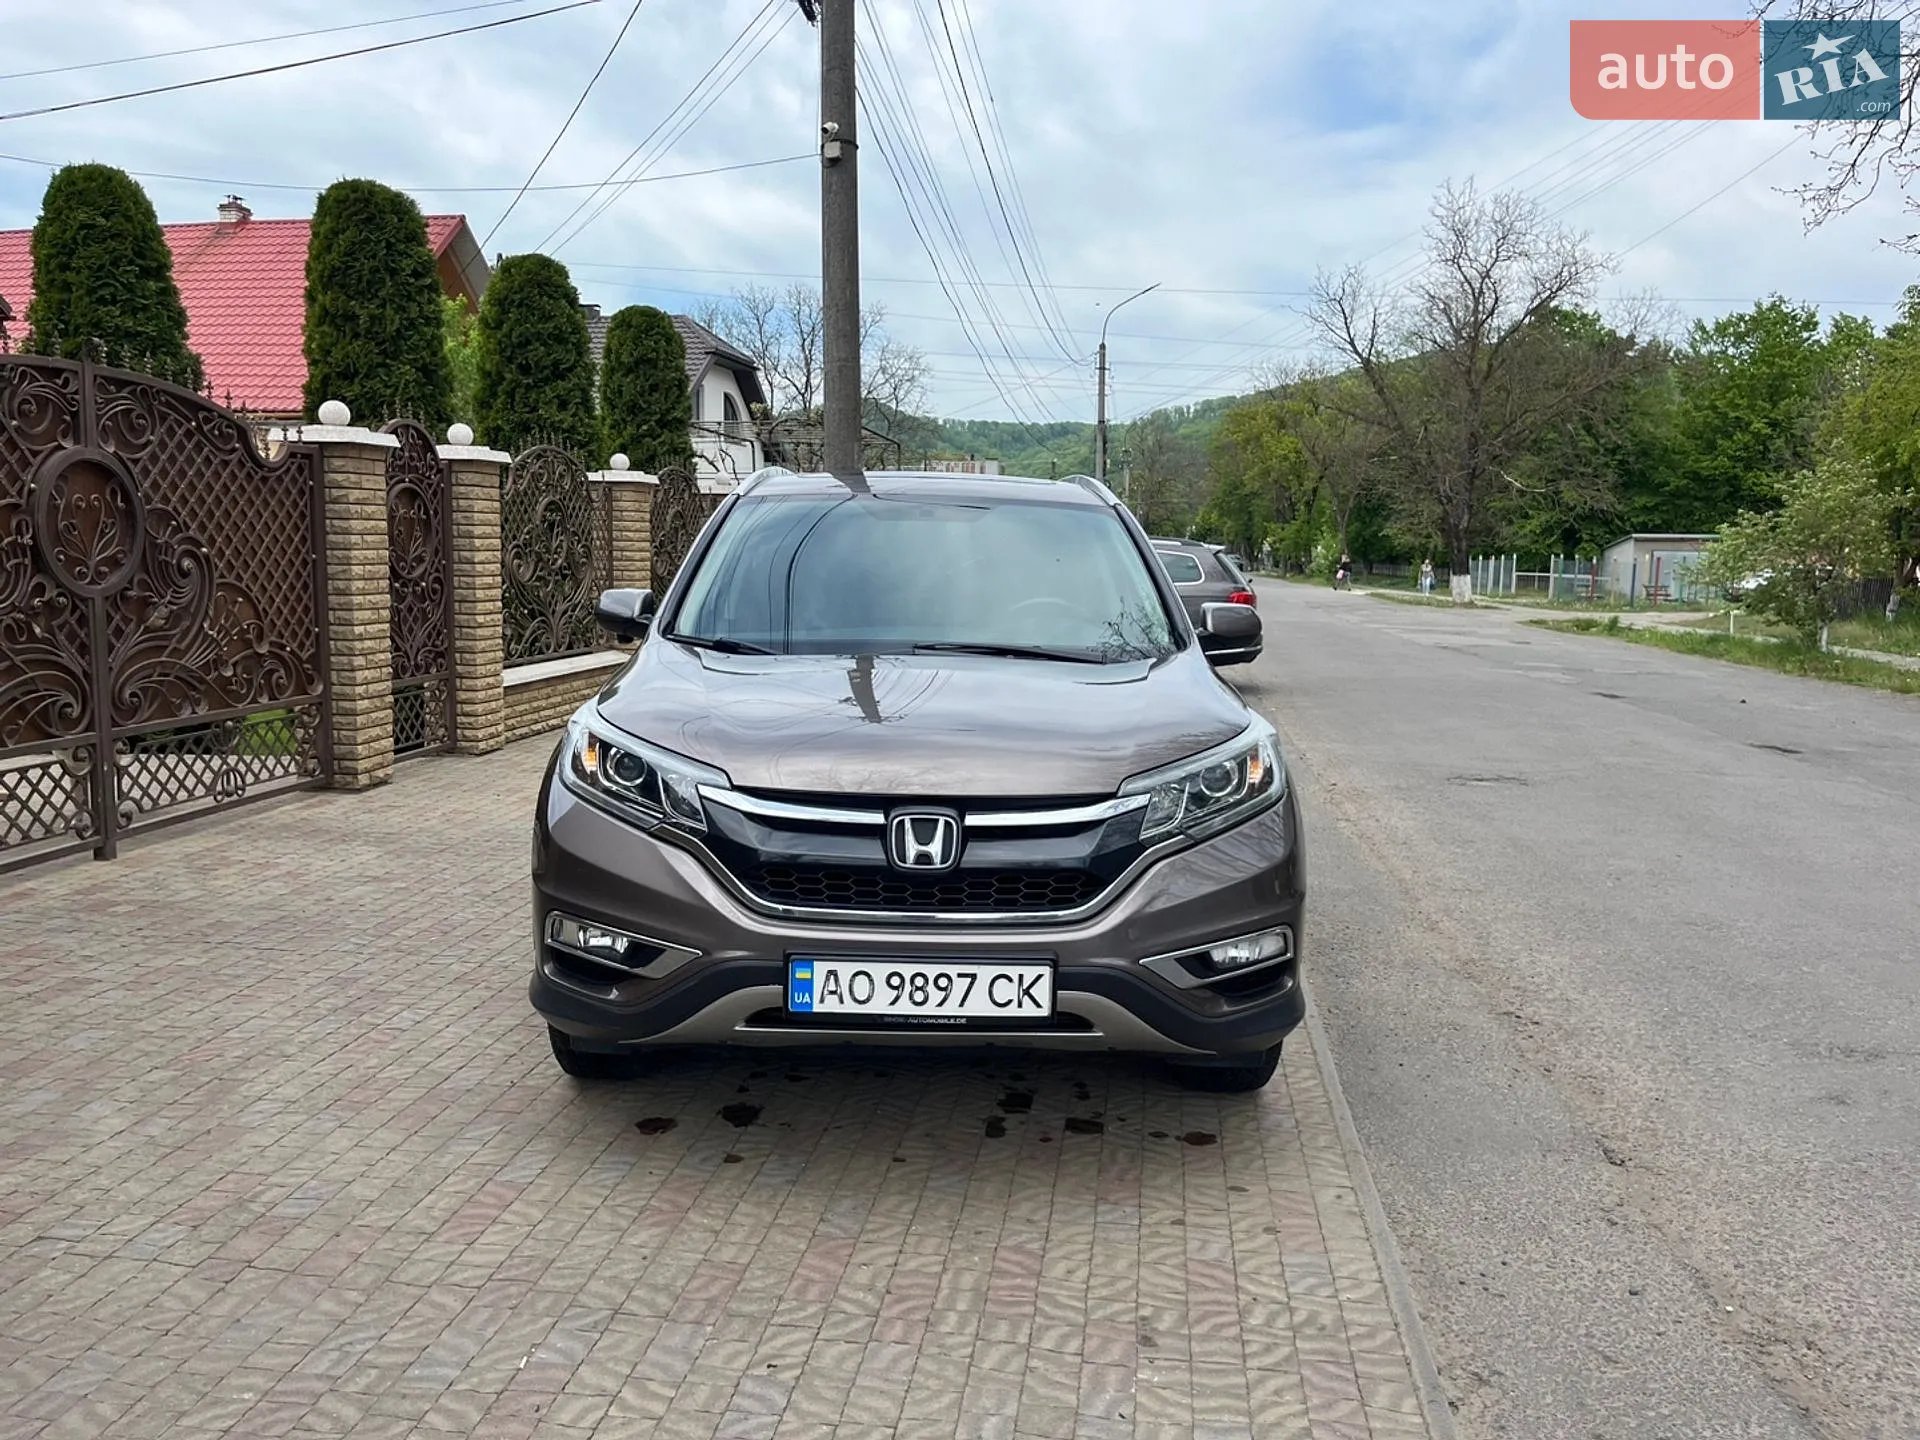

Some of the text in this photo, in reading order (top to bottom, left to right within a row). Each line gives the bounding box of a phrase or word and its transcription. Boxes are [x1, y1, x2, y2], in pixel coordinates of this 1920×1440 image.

[794, 993, 811, 1004] UA
[819, 969, 1044, 1009] AO 9897 CK
